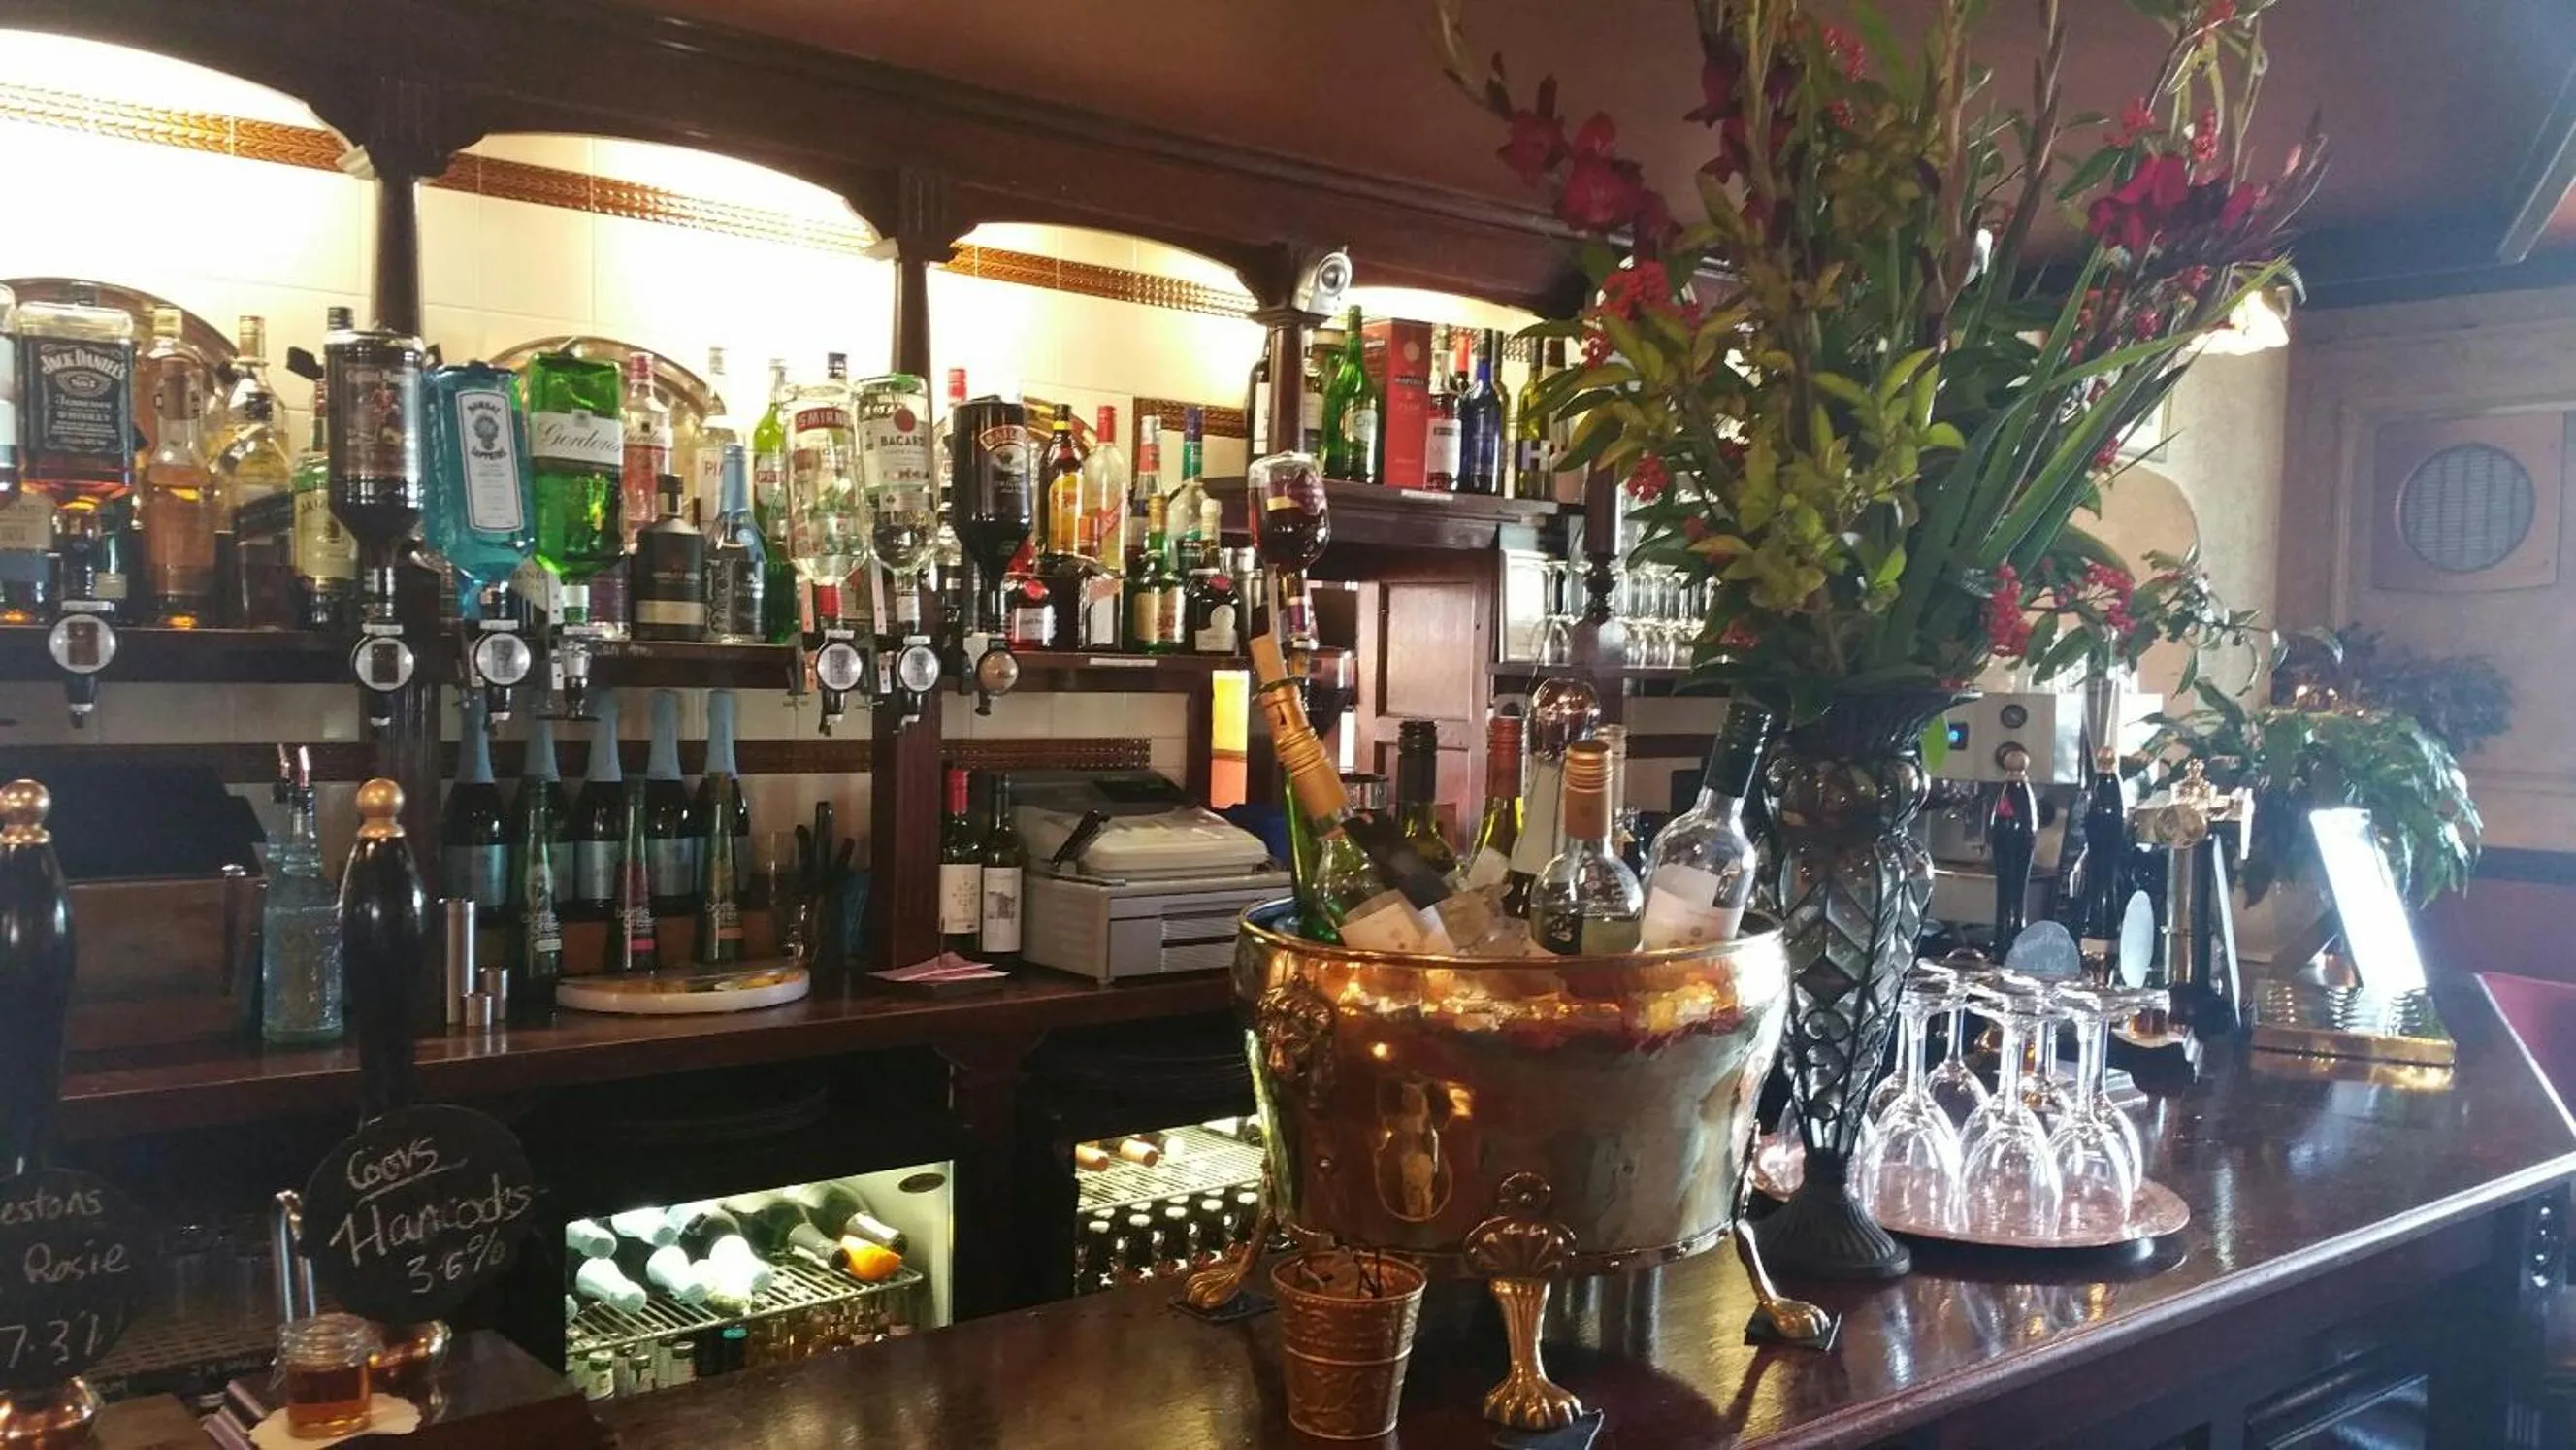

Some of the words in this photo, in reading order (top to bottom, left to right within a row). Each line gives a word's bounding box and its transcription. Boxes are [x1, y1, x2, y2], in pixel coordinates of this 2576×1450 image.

[41, 352, 76, 375] JACK
[797, 408, 854, 428] SMIRN
[880, 435, 925, 447] BACAR
[0, 1188, 104, 1225] estons
[23, 1238, 130, 1284] Rosie
